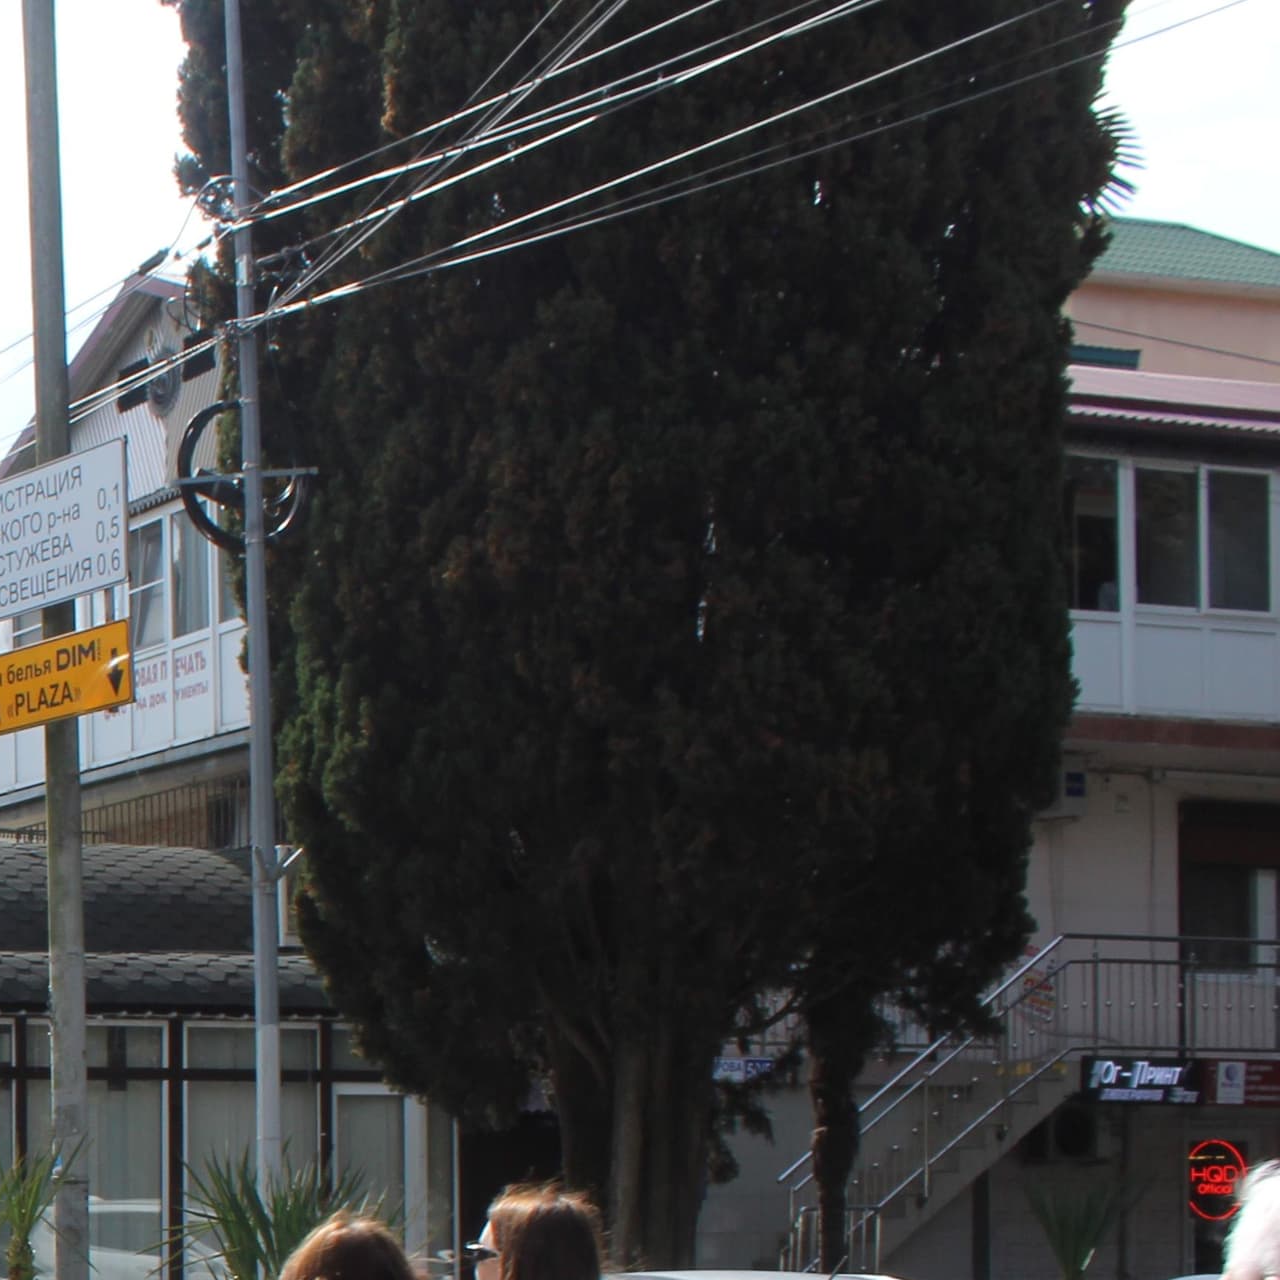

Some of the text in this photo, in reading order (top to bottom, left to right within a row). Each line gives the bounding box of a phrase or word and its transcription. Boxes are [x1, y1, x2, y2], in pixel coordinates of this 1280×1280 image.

[46, 502, 81, 533] р-на
[96, 483, 121, 511] 0,1
[95, 518, 120, 543] 0,5
[96, 547, 122, 578] 0,6
[6, 657, 52, 687] белья
[55, 640, 96, 672] DIM
[7, 681, 82, 719] «PLAZA»
[1190, 1165, 1239, 1183] HQD
